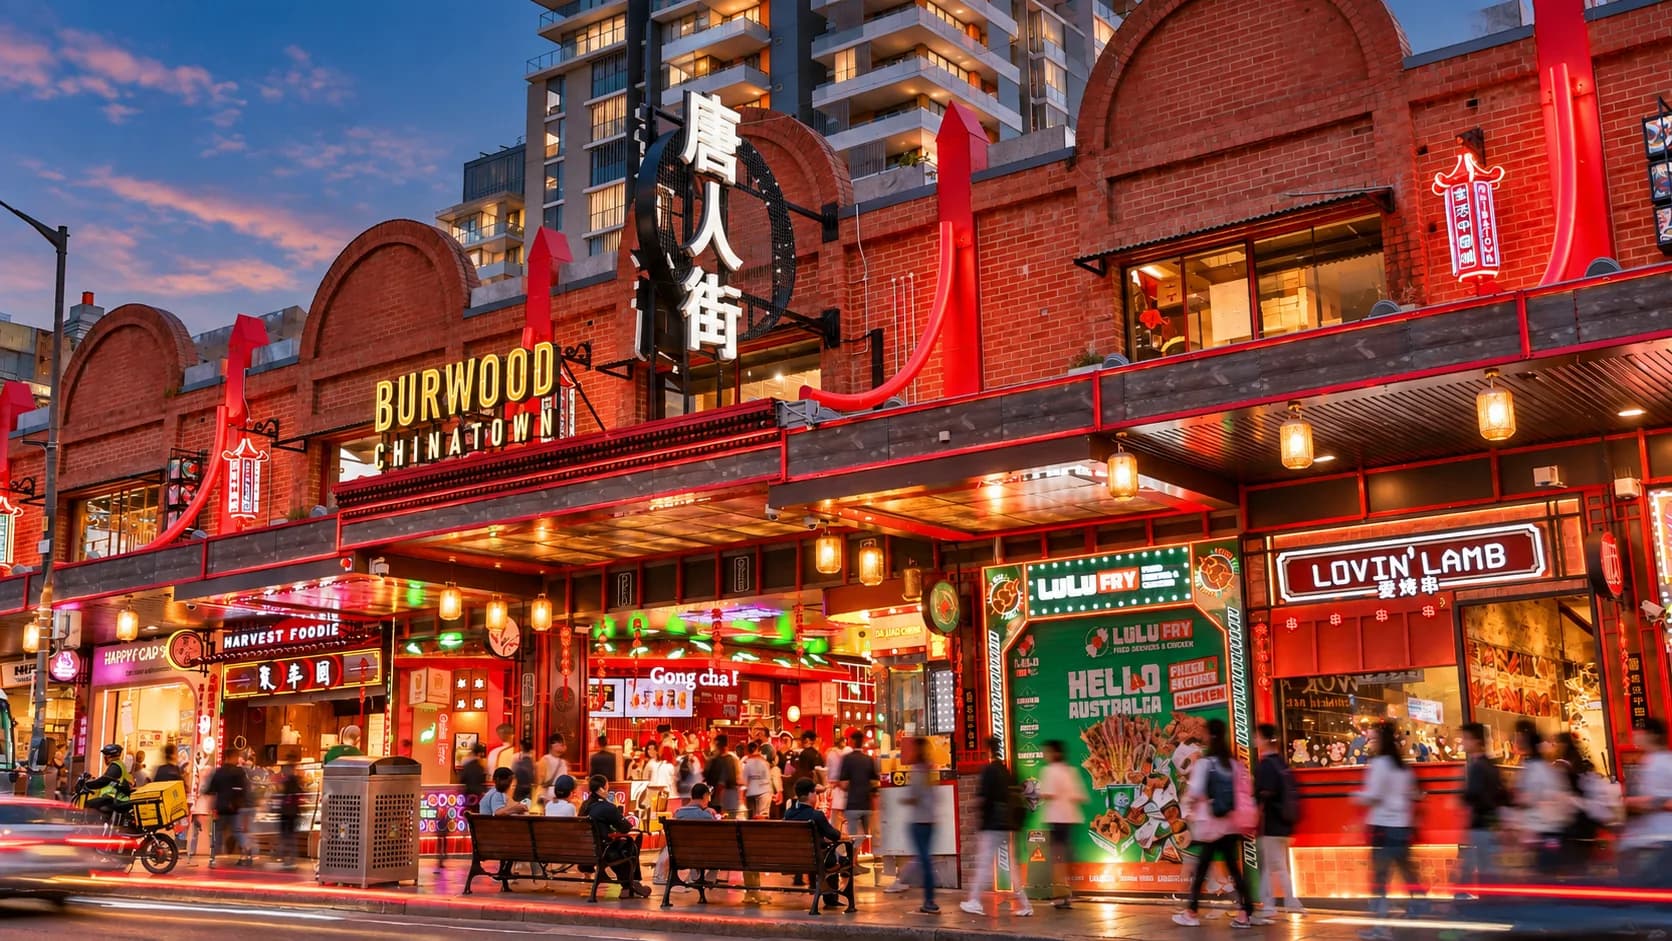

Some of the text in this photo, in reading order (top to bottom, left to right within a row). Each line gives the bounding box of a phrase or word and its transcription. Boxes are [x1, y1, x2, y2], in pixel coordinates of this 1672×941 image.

[680, 91, 743, 361] 唐人街
[374, 341, 554, 433] BURWOOD
[374, 408, 554, 471] CHINATOWN
[1422, 542, 1507, 577] LAMB
[1099, 570, 1138, 592] FRY
[1378, 575, 1439, 599] 爱烤串
[224, 623, 339, 649] HARVEST FOODIE
[1162, 620, 1191, 638] FRY
[650, 666, 697, 690] Gong
[699, 667, 729, 687] cha
[1068, 663, 1161, 700] HELLO
